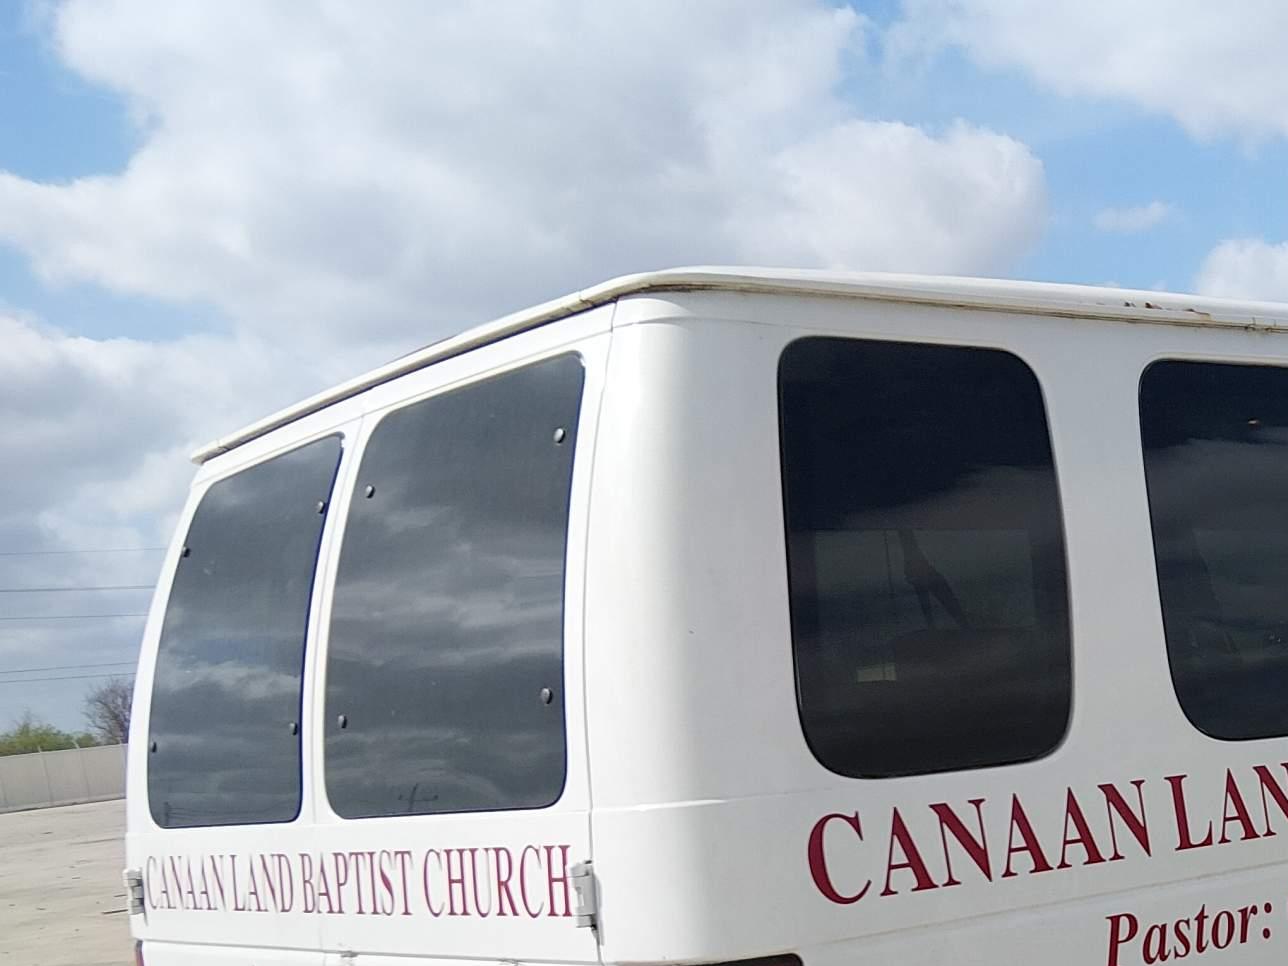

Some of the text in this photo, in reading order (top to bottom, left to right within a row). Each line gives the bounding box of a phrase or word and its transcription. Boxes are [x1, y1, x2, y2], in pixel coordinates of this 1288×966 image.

[146, 845, 573, 919] CANAAN LAND BAPTIST CHURCH
[807, 780, 1152, 905] CANAAN
